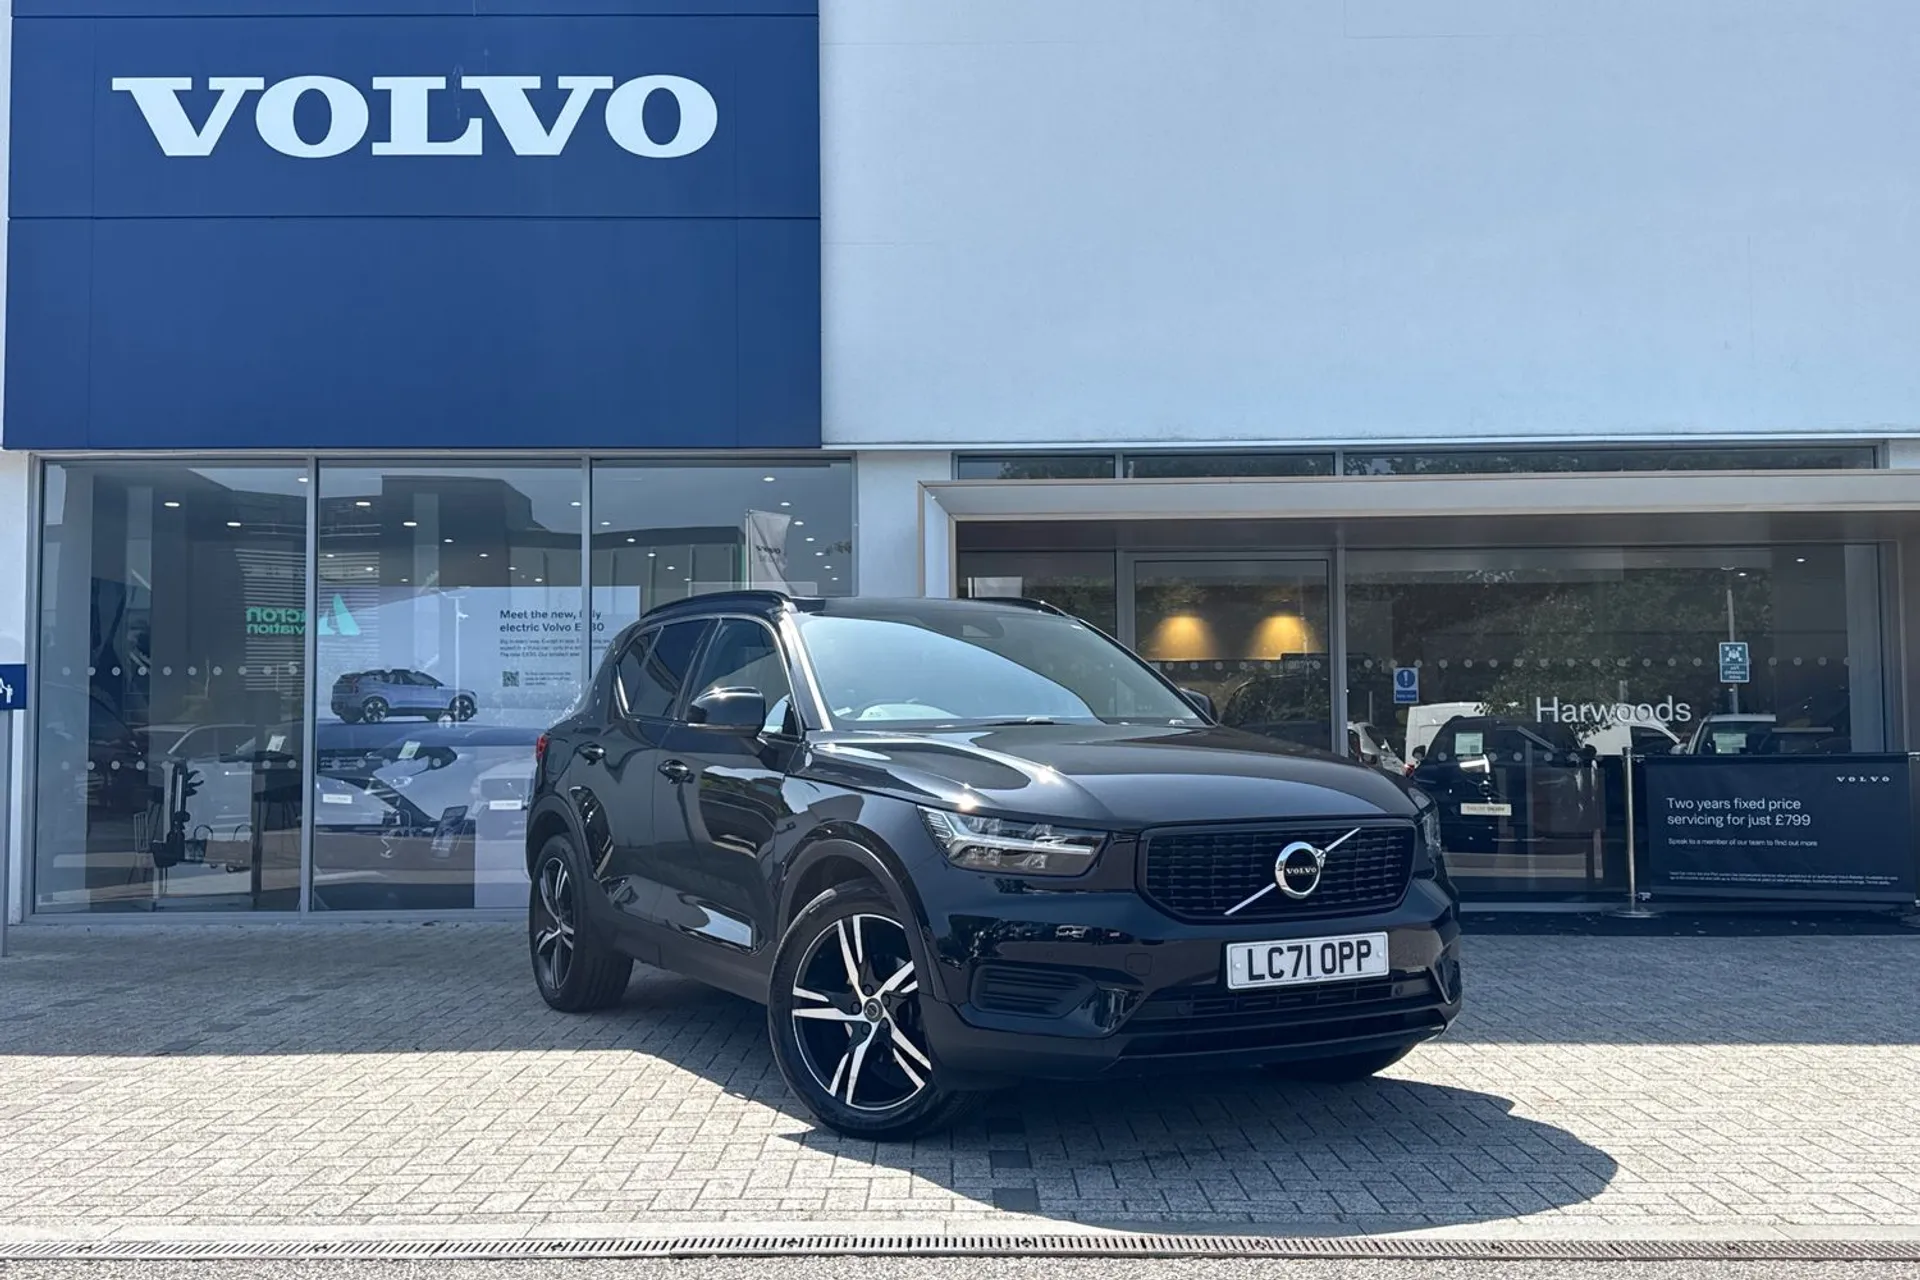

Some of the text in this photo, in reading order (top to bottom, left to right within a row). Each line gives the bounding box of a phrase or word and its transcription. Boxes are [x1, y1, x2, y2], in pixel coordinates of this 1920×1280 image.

[112, 75, 718, 158] VOLVO
[500, 610, 528, 619] Meet
[531, 610, 548, 619] the
[550, 611, 576, 621] new,
[500, 622, 605, 632] electric Volvo E30
[1536, 695, 1692, 723] Harwoods
[1667, 797, 1801, 812] Two years fixed price
[1667, 813, 1811, 828] servicing for just £799
[1286, 867, 1317, 875] VOLVO
[1247, 939, 1372, 981] LC71 OPP
